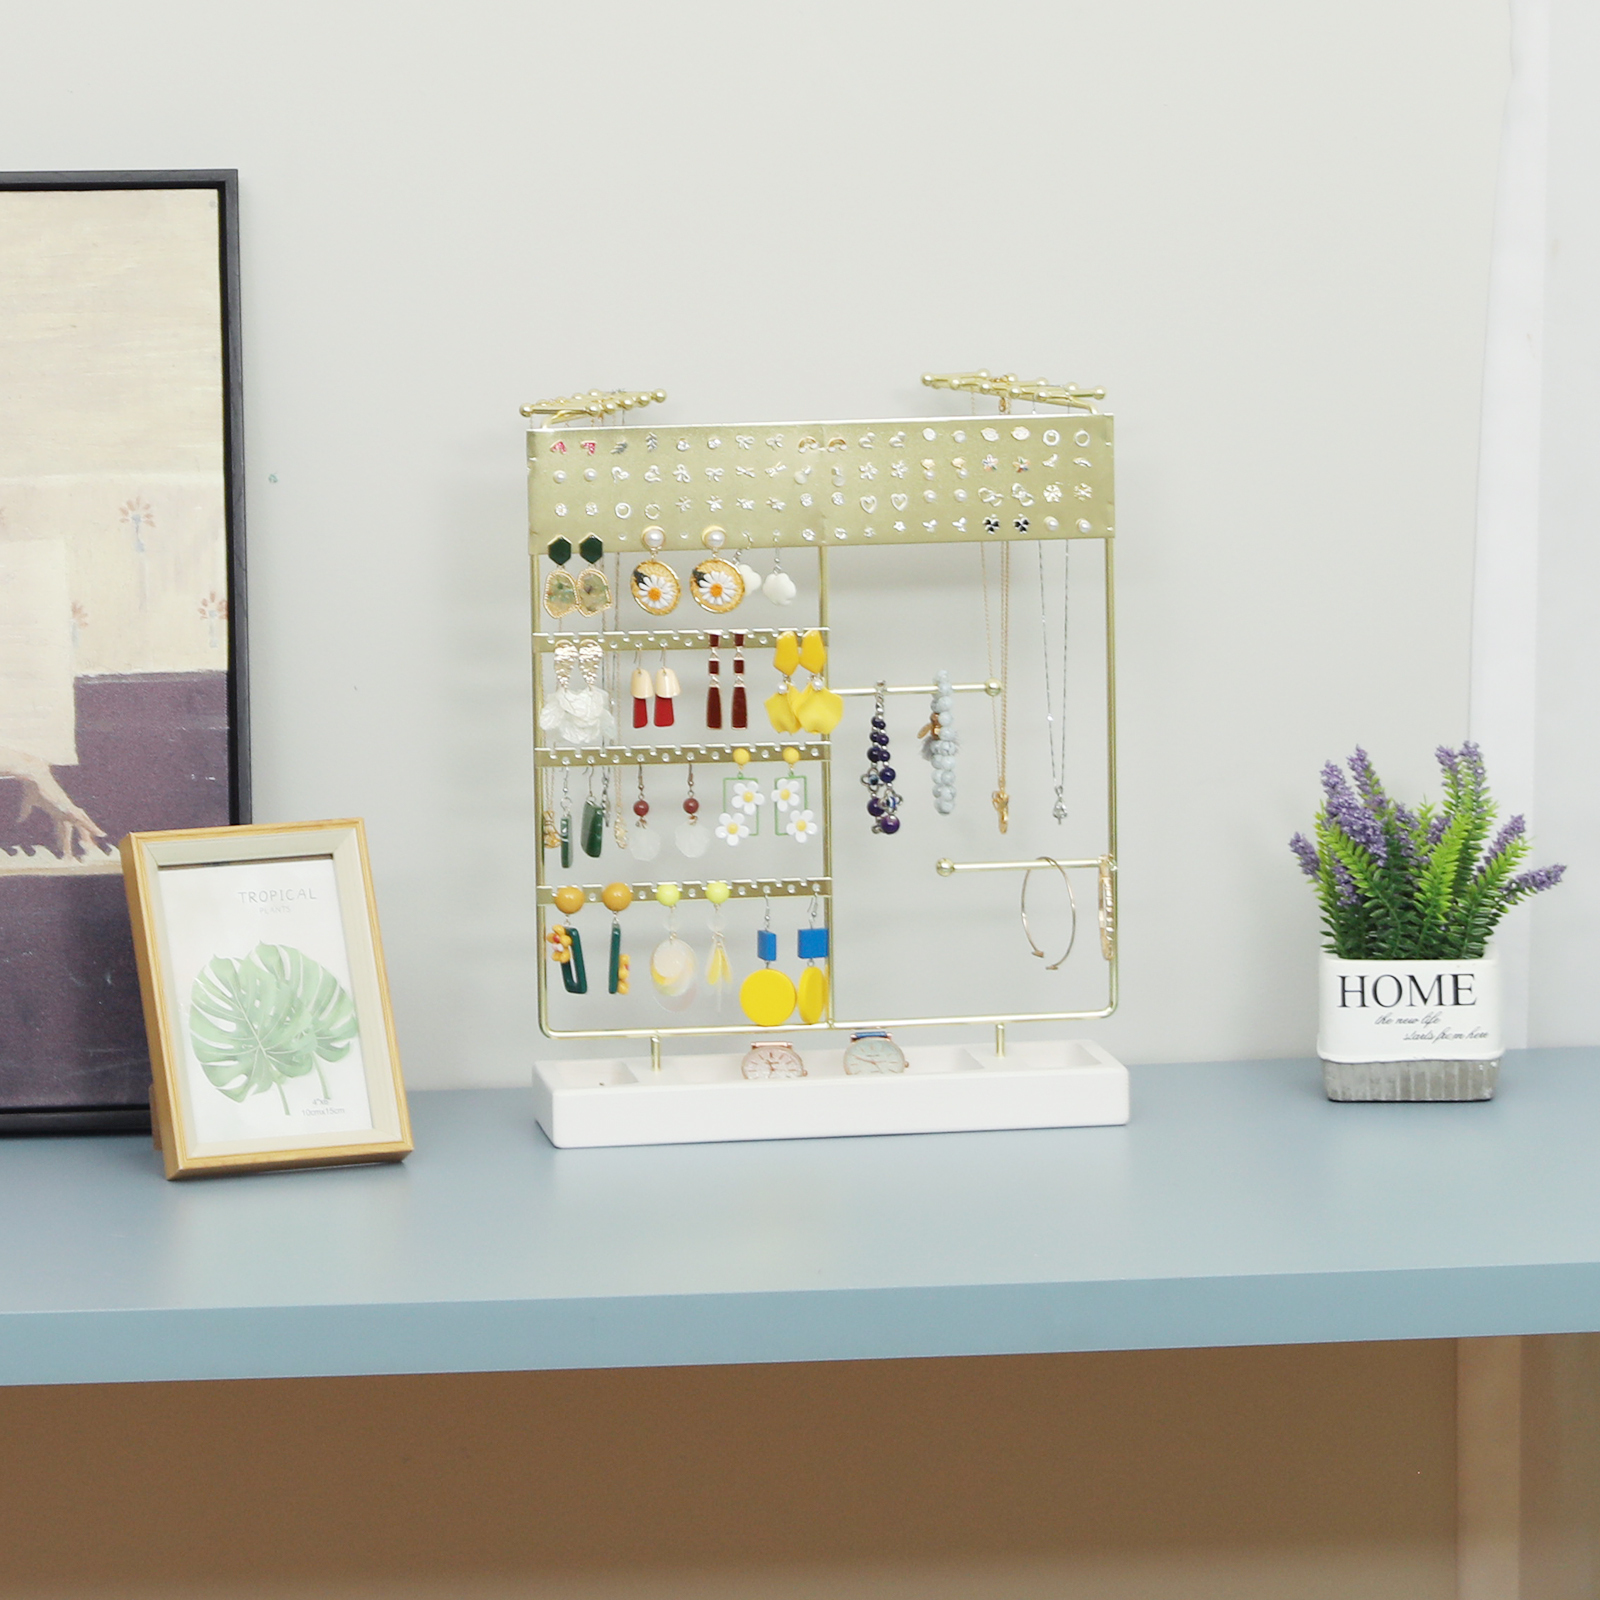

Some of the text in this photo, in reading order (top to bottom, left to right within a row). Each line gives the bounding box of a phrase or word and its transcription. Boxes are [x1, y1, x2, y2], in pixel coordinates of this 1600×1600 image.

[238, 888, 317, 903] TROPICAL
[259, 905, 291, 914] PLANTS
[1337, 973, 1477, 1008] HOME
[1374, 1011, 1442, 1028] the new life
[1466, 1026, 1490, 1040] here
